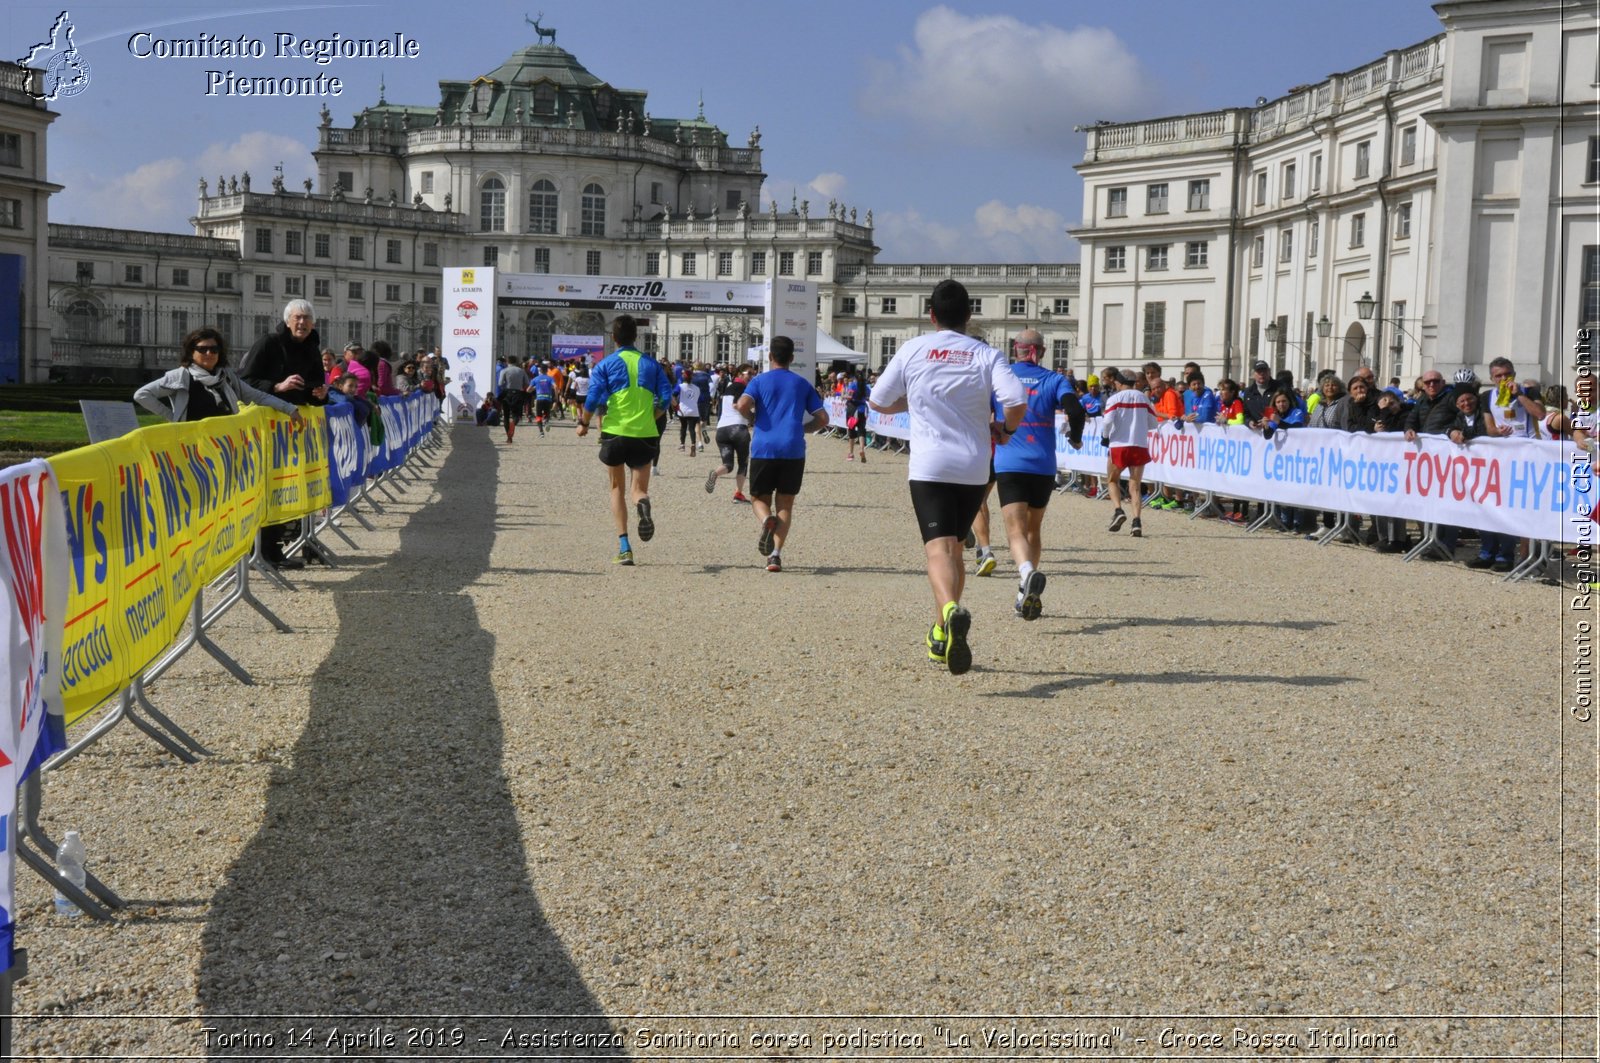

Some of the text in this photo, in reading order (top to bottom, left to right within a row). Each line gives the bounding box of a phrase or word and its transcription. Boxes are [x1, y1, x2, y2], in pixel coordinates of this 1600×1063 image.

[512, 299, 570, 307] #SOSTIENICANDIOLO
[614, 301, 652, 311] ARRIVO
[691, 305, 747, 313] #SOSTIENICANDIOLO
[453, 328, 480, 336] GIMAX
[1147, 432, 1195, 468] TOYOTA
[1198, 437, 1252, 476] HYBRID
[1263, 442, 1325, 485] Central
[1328, 447, 1399, 494] Motors
[1404, 451, 1501, 507] TOYOTA
[125, 578, 166, 644] mercato
[60, 615, 113, 692] ercato
